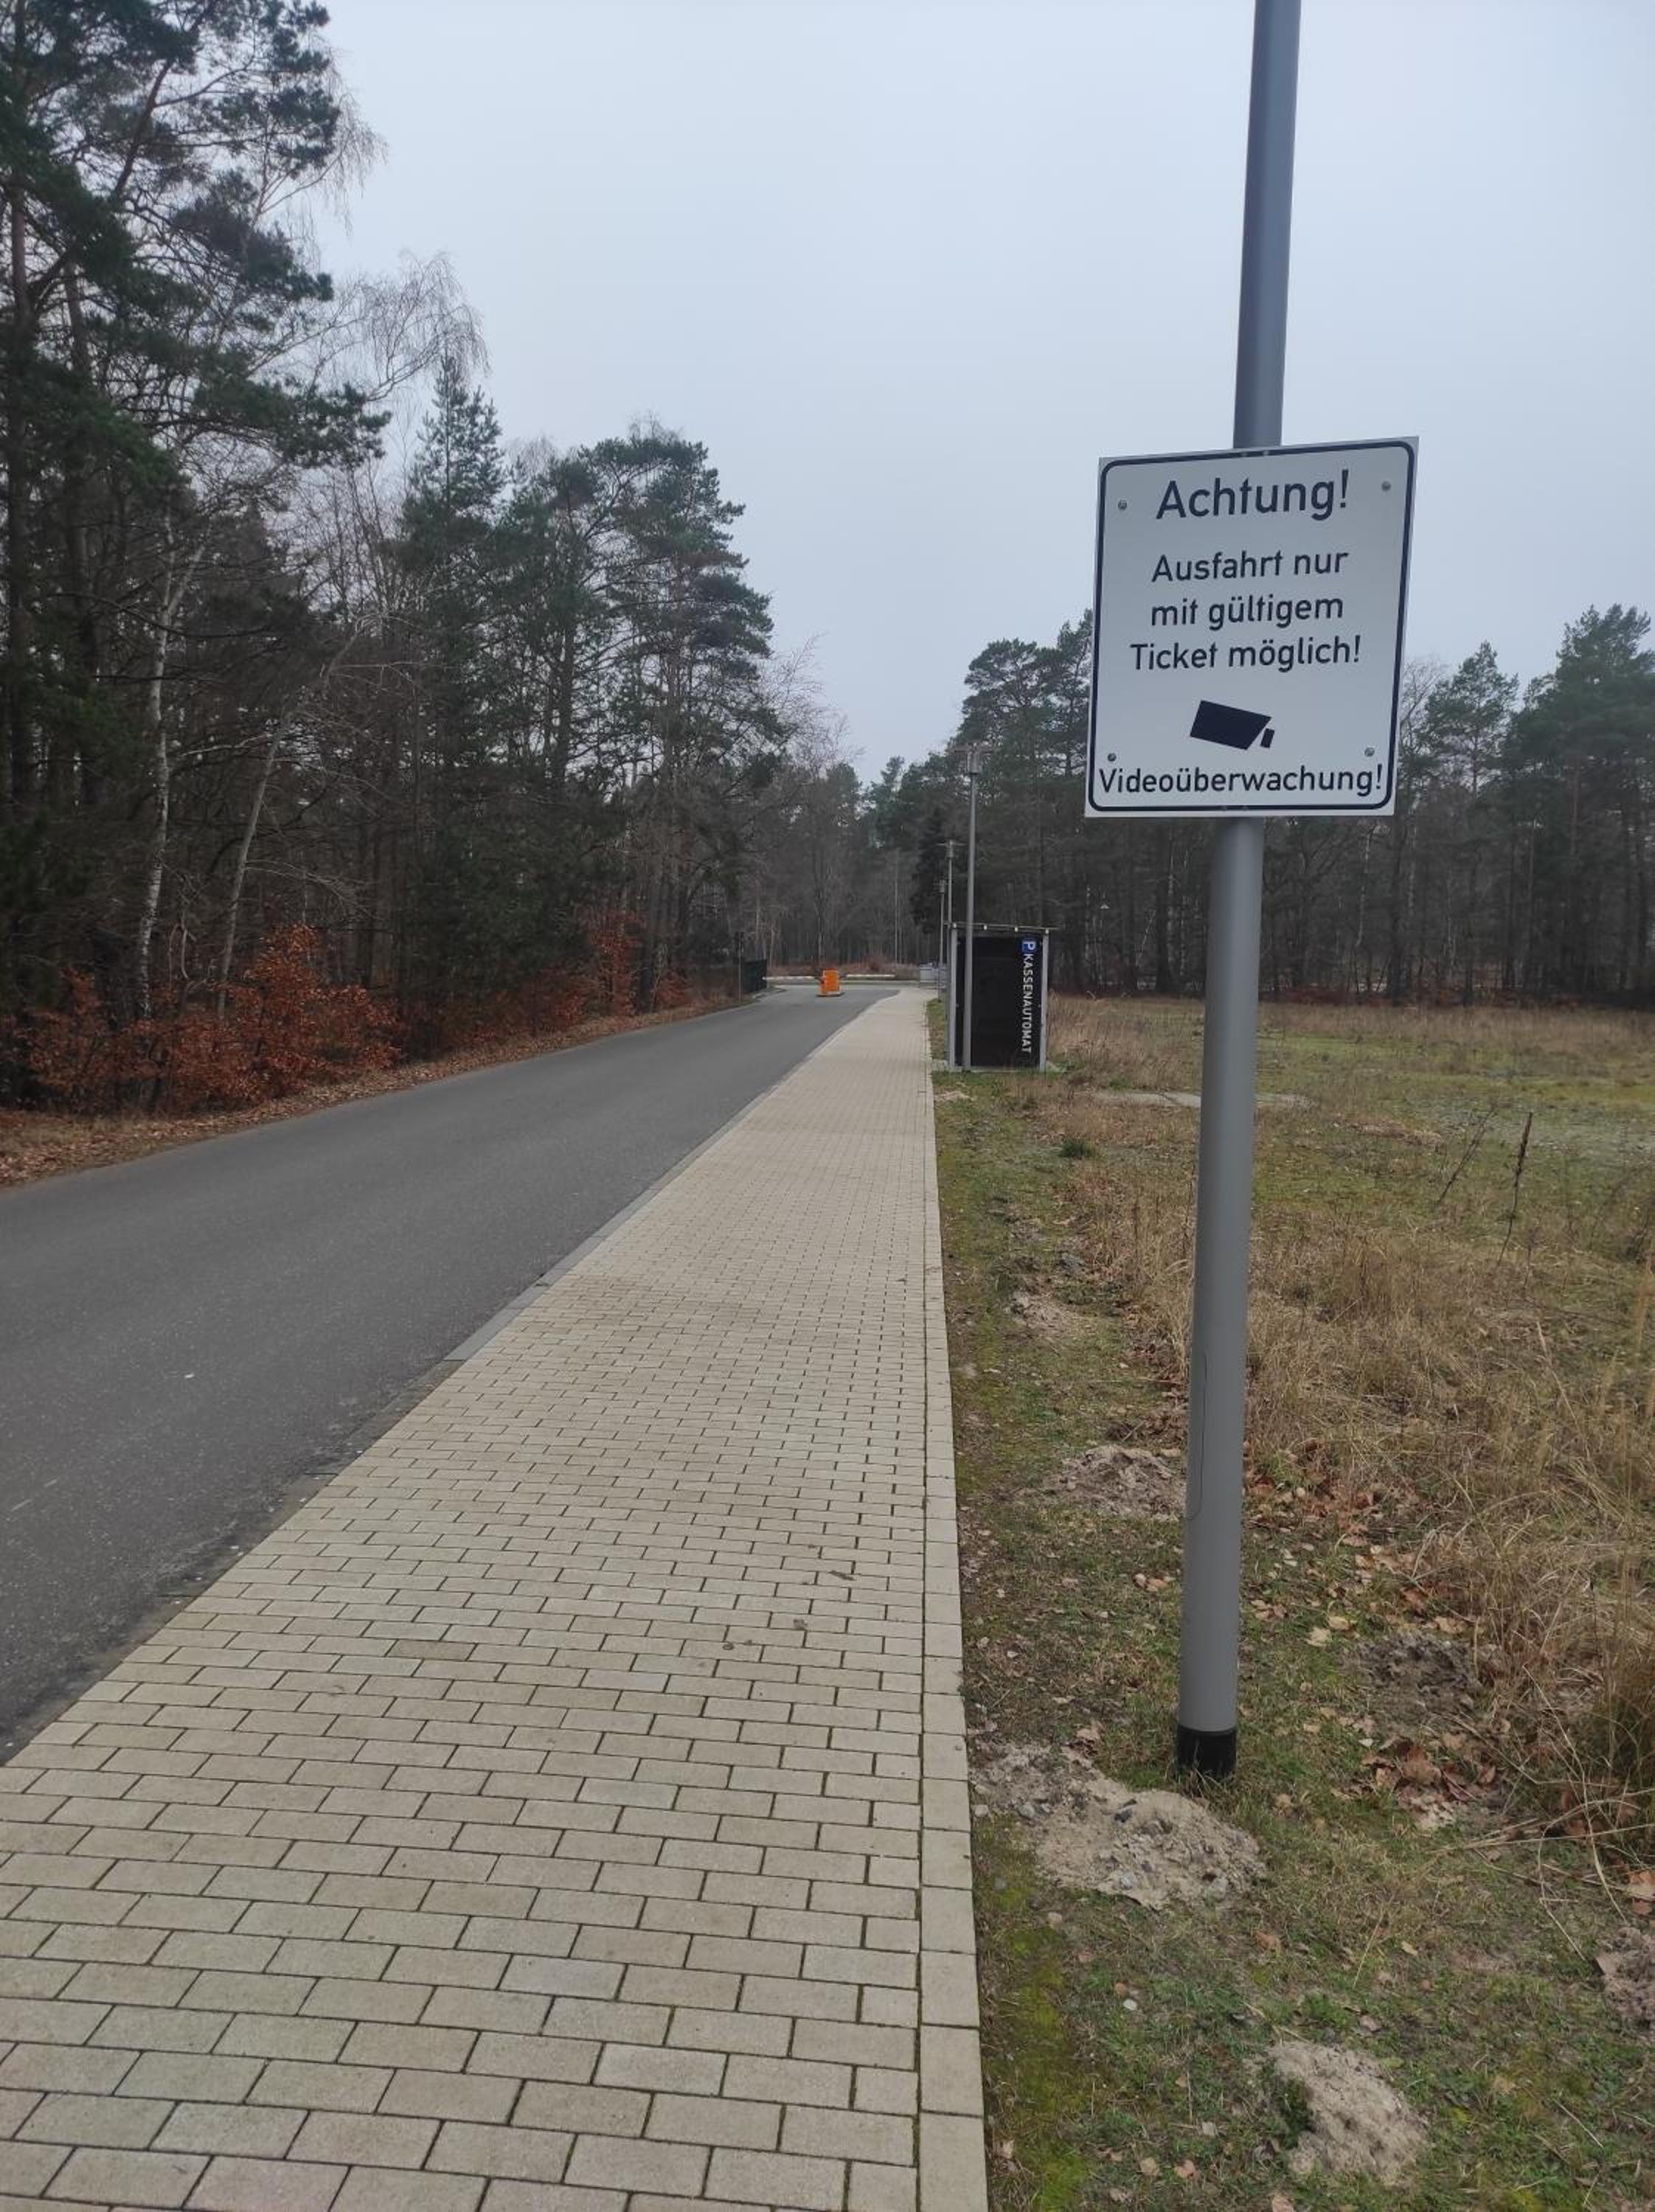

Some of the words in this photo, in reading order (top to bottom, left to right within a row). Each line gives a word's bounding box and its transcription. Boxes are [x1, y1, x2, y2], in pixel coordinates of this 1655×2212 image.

[1156, 470, 1350, 521] Achtung!
[1151, 551, 1283, 582] Ausfahrt
[1294, 551, 1350, 575] nur
[1151, 599, 1198, 626] mit
[1208, 594, 1344, 630] gültigem
[1130, 642, 1219, 670] Ticket
[1228, 635, 1361, 672] möglich!
[1098, 764, 1384, 796] Videoüberwachung!
[1022, 941, 1036, 950] P
[1021, 953, 1034, 1054] KASSENAUTOMAT
